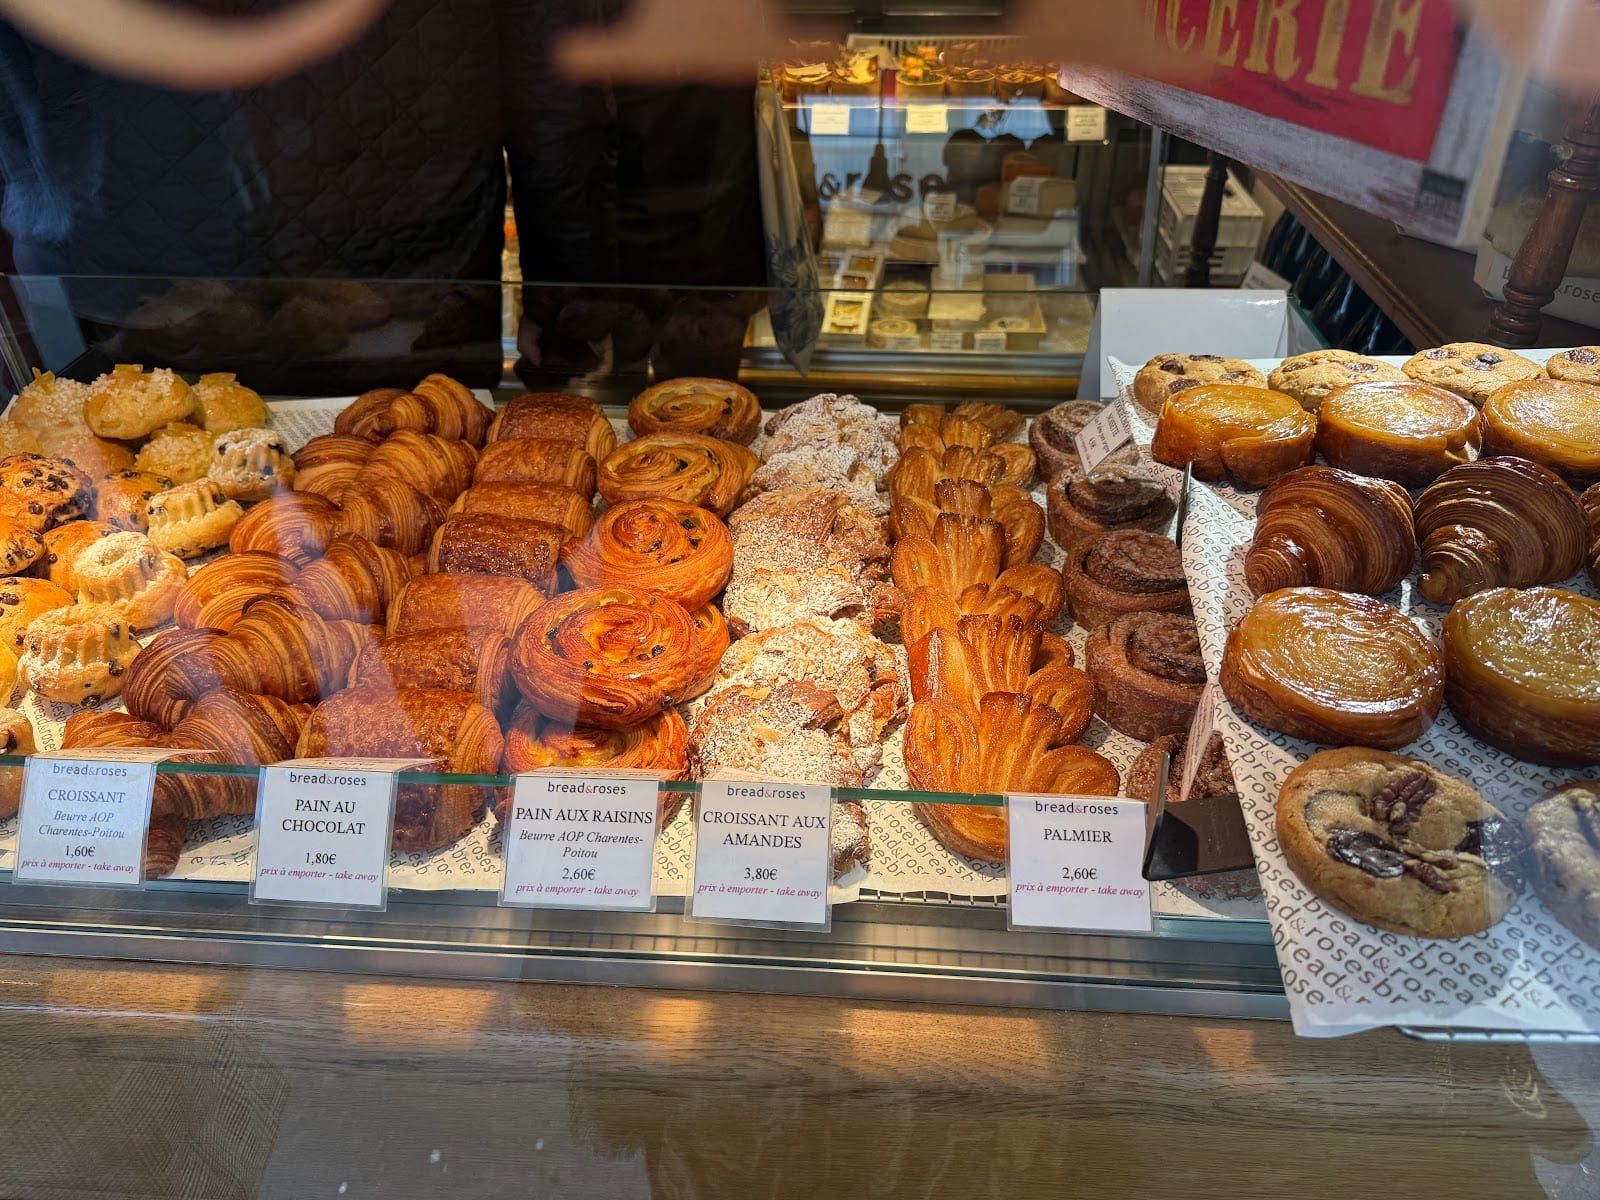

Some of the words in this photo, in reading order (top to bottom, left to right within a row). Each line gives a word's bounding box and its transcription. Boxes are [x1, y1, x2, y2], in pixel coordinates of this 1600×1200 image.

[1144, 0, 1422, 106] CERIE
[53, 763, 127, 777] bread&roses
[289, 771, 367, 786] bread&roses
[548, 781, 626, 795] bread&roses
[727, 785, 806, 800] bread&roses
[48, 789, 126, 803] CROISSANT
[295, 799, 331, 812] PAIN
[333, 800, 356, 814] AU
[1035, 800, 1119, 815] bread&roses
[54, 810, 87, 821] Beurre
[89, 812, 114, 823] AOP
[515, 808, 552, 821] PAIN
[554, 809, 590, 822] AUX
[592, 811, 653, 824] RAISINS
[703, 811, 789, 827] CROISSANT
[792, 815, 827, 829] AUX
[38, 824, 125, 839] Charentes-Poitou
[282, 818, 366, 835] CHOCOLAT
[519, 829, 556, 841] Beurre
[557, 831, 585, 842] AOP
[586, 832, 645, 845] Charentes-
[722, 833, 802, 849] AMANDES
[1044, 828, 1113, 843] PALMIER
[65, 845, 96, 858] 1,60€
[305, 852, 337, 865] 1,80€
[562, 847, 599, 859] Poitou
[21, 859, 38, 869] prix
[40, 859, 47, 868] à
[48, 861, 87, 871] emporter
[93, 862, 112, 871] take
[113, 864, 136, 874] away
[743, 867, 778, 881] 3,80€
[1062, 867, 1097, 881] 2,60€
[260, 866, 279, 877] prix
[280, 867, 286, 876] à
[288, 869, 327, 879] emporter
[335, 871, 353, 880] take
[354, 873, 379, 883] away
[562, 868, 596, 881] 2,60€
[515, 883, 534, 894] prix
[536, 883, 543, 893] à
[545, 886, 586, 896] emporter
[594, 887, 613, 895] take
[614, 888, 640, 898] away
[697, 883, 716, 894] prix
[718, 883, 725, 893] à
[726, 885, 768, 896] emporter
[776, 888, 795, 896] take
[797, 889, 822, 900] away
[1015, 882, 1035, 893] prix
[1037, 882, 1043, 891] à
[1046, 884, 1089, 895] emporter
[1097, 887, 1117, 895] take
[1119, 888, 1145, 898] away
